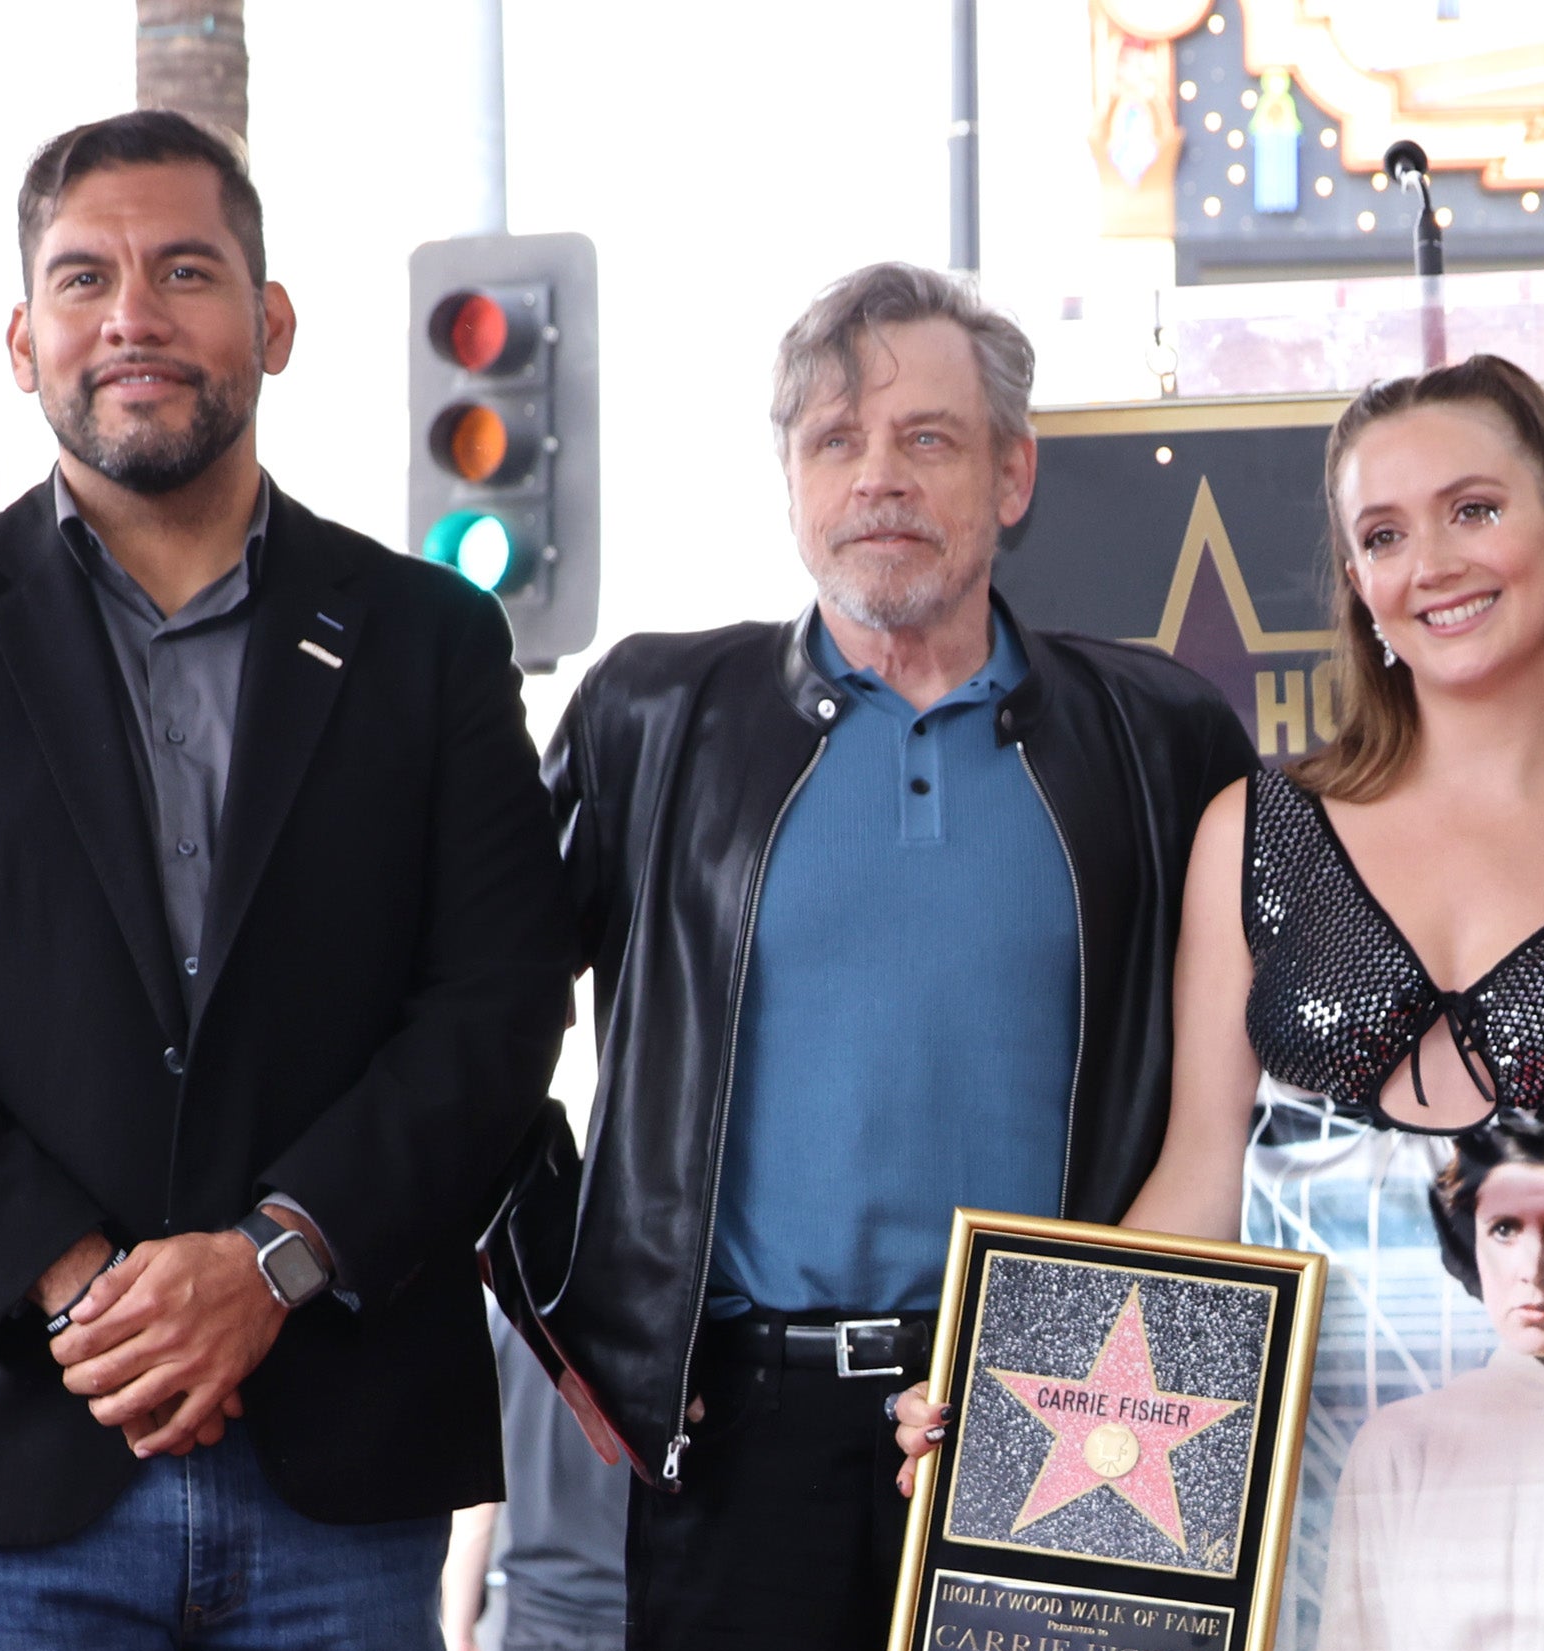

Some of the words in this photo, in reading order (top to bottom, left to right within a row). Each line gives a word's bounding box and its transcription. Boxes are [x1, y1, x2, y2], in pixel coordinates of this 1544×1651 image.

[1037, 1387, 1109, 1416] CARRIE
[1118, 1397, 1191, 1427] FISHER
[941, 1583, 1063, 1616] HOLLYWOOD
[1068, 1600, 1127, 1624] WALK
[1132, 1609, 1159, 1629] OF
[1164, 1613, 1221, 1637] FAME
